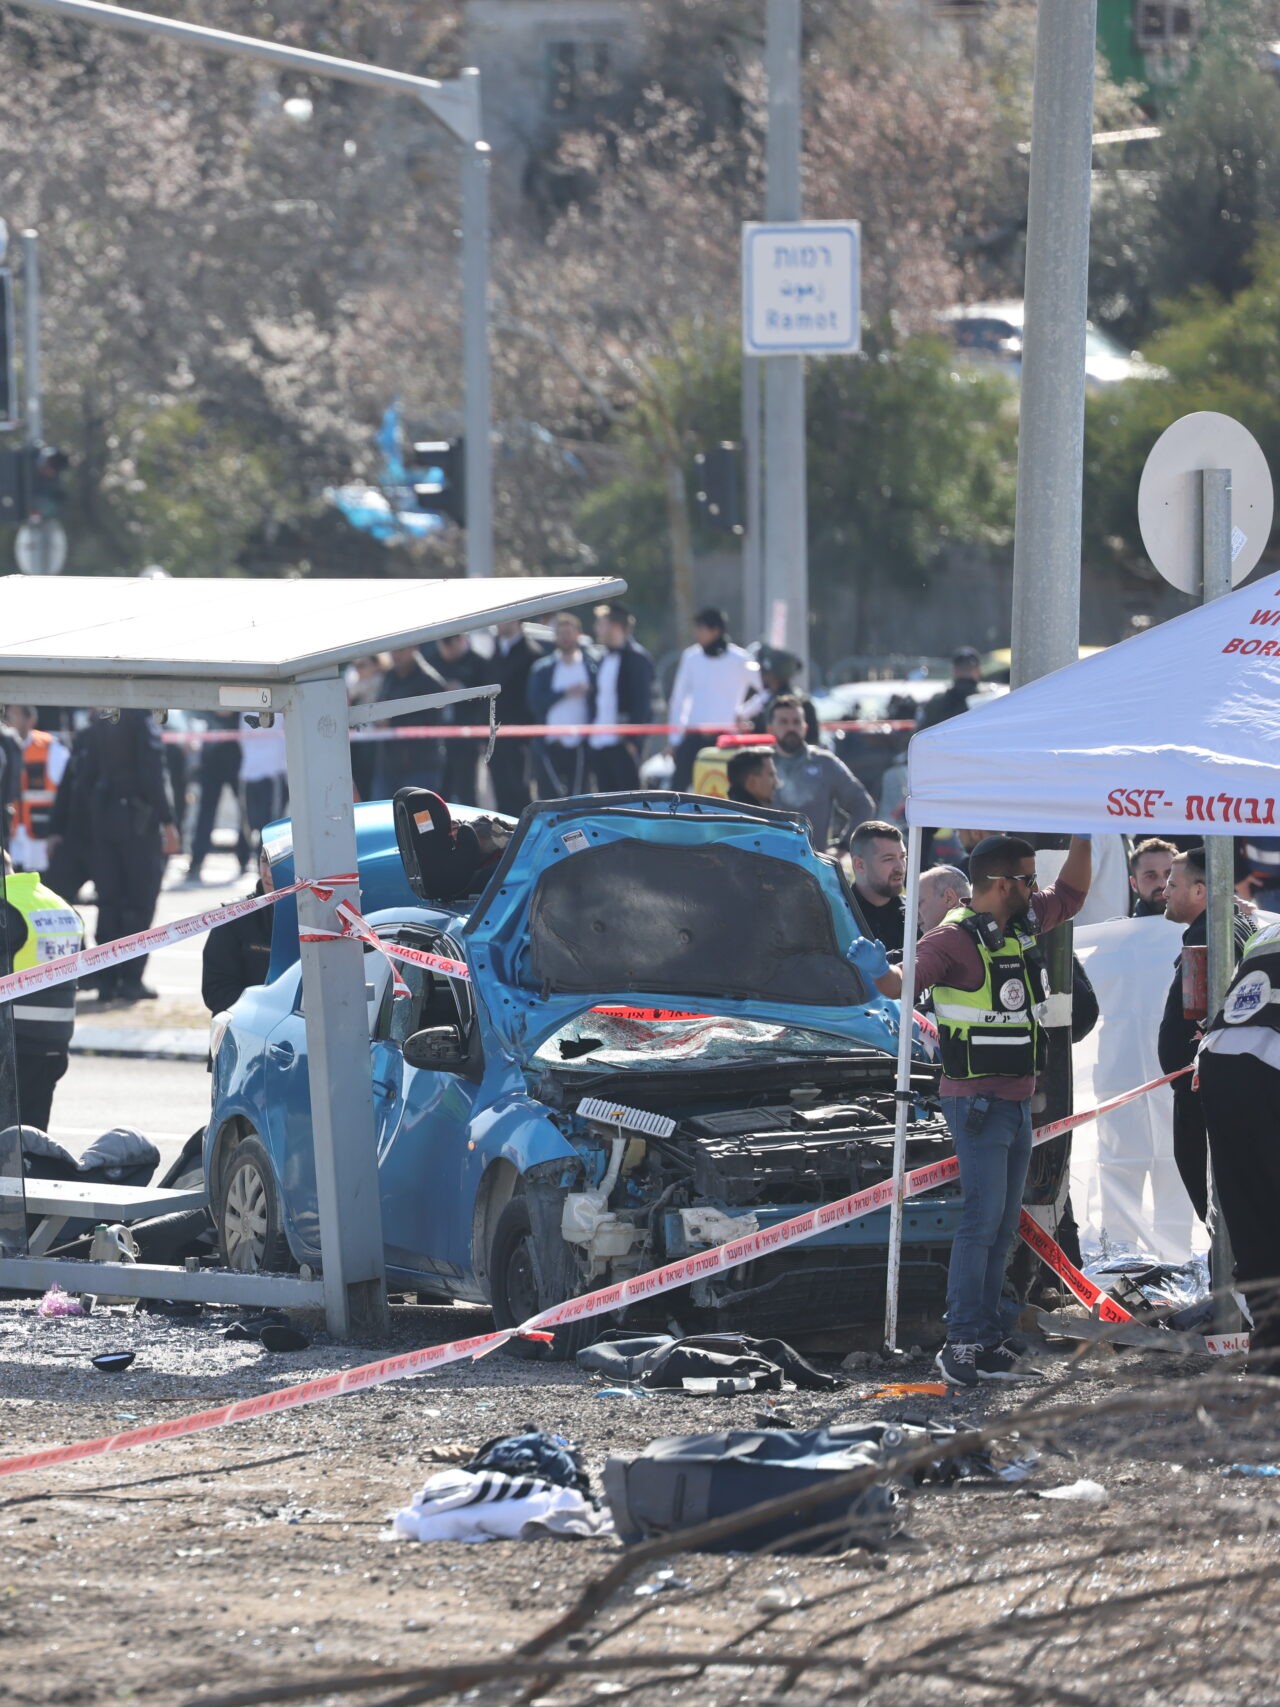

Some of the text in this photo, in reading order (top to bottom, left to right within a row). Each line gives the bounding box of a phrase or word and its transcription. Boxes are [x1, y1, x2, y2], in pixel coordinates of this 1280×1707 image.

[766, 308, 837, 330] Ramot
[1184, 793, 1276, 825] גבולות
[911, 1170, 938, 1187] אין מעבר
[820, 1195, 871, 1224] ישראל אין מעבר
[726, 1218, 813, 1260] משטרת ישראל אין מעבר
[628, 1254, 719, 1296] משטרת ישראל אין מעבר
